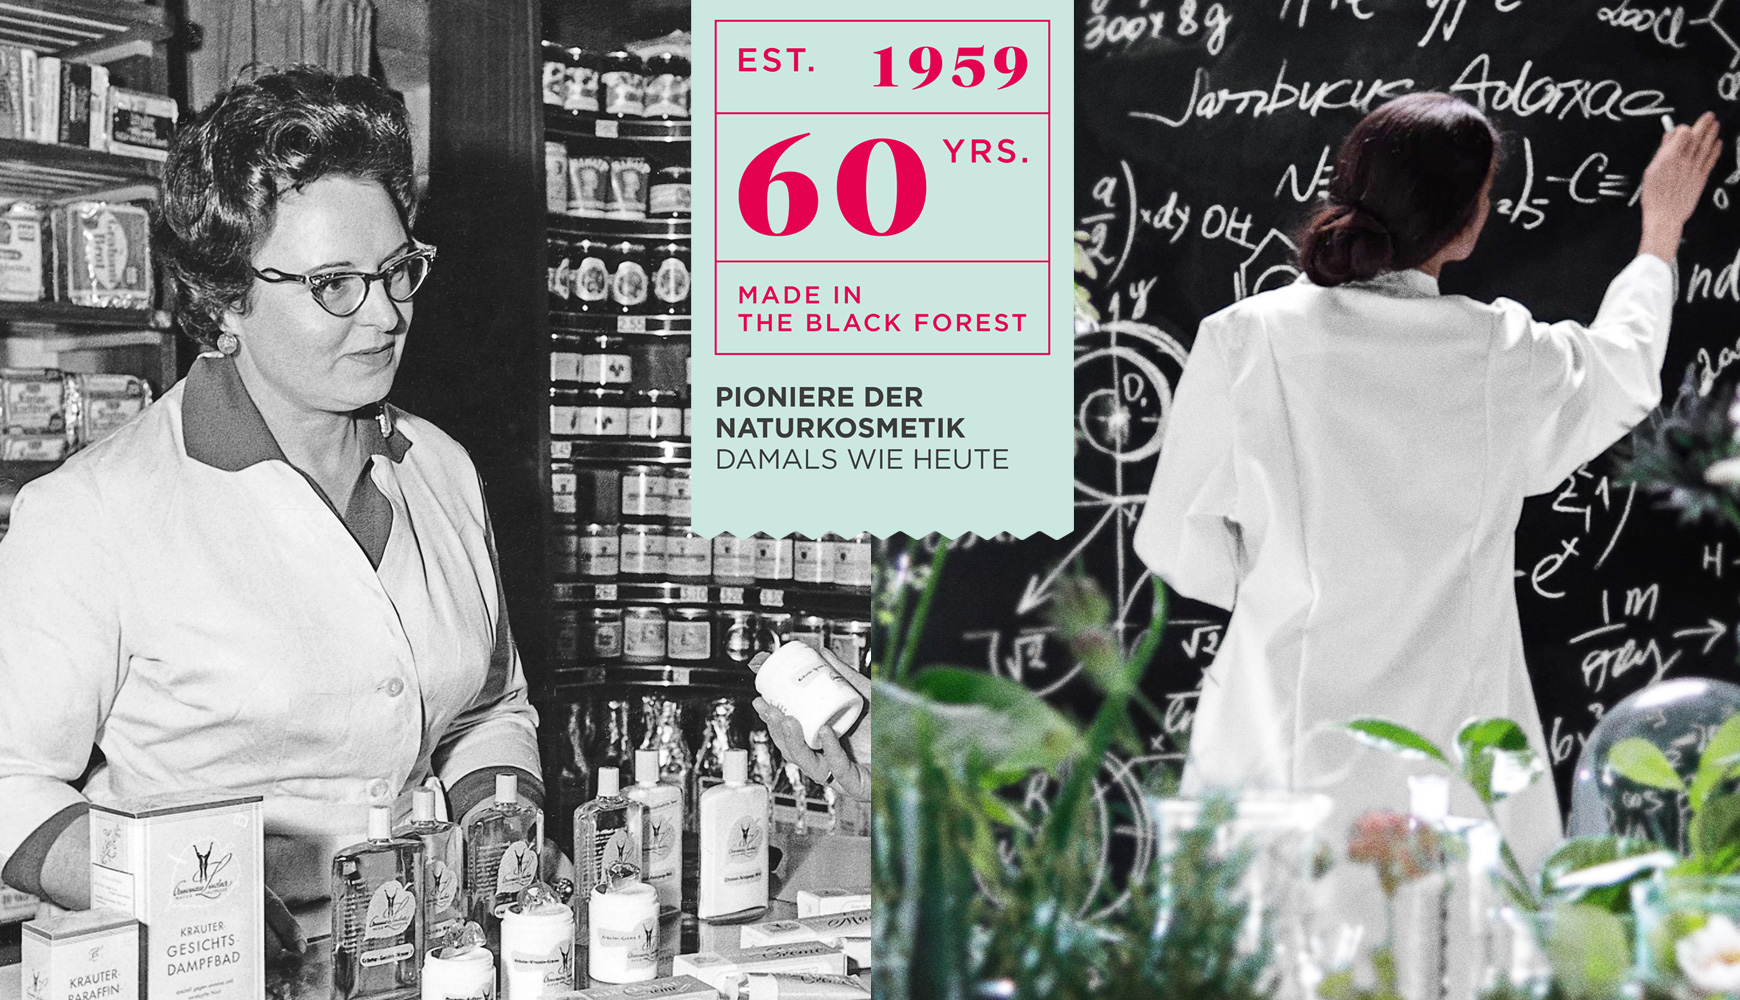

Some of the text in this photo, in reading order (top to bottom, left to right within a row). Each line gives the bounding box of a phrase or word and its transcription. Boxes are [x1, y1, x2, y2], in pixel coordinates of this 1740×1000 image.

[166, 934, 240, 958] GESICHTS-
[167, 951, 241, 977] DAMPFBAD
[69, 969, 122, 989] KRÄUTER-
